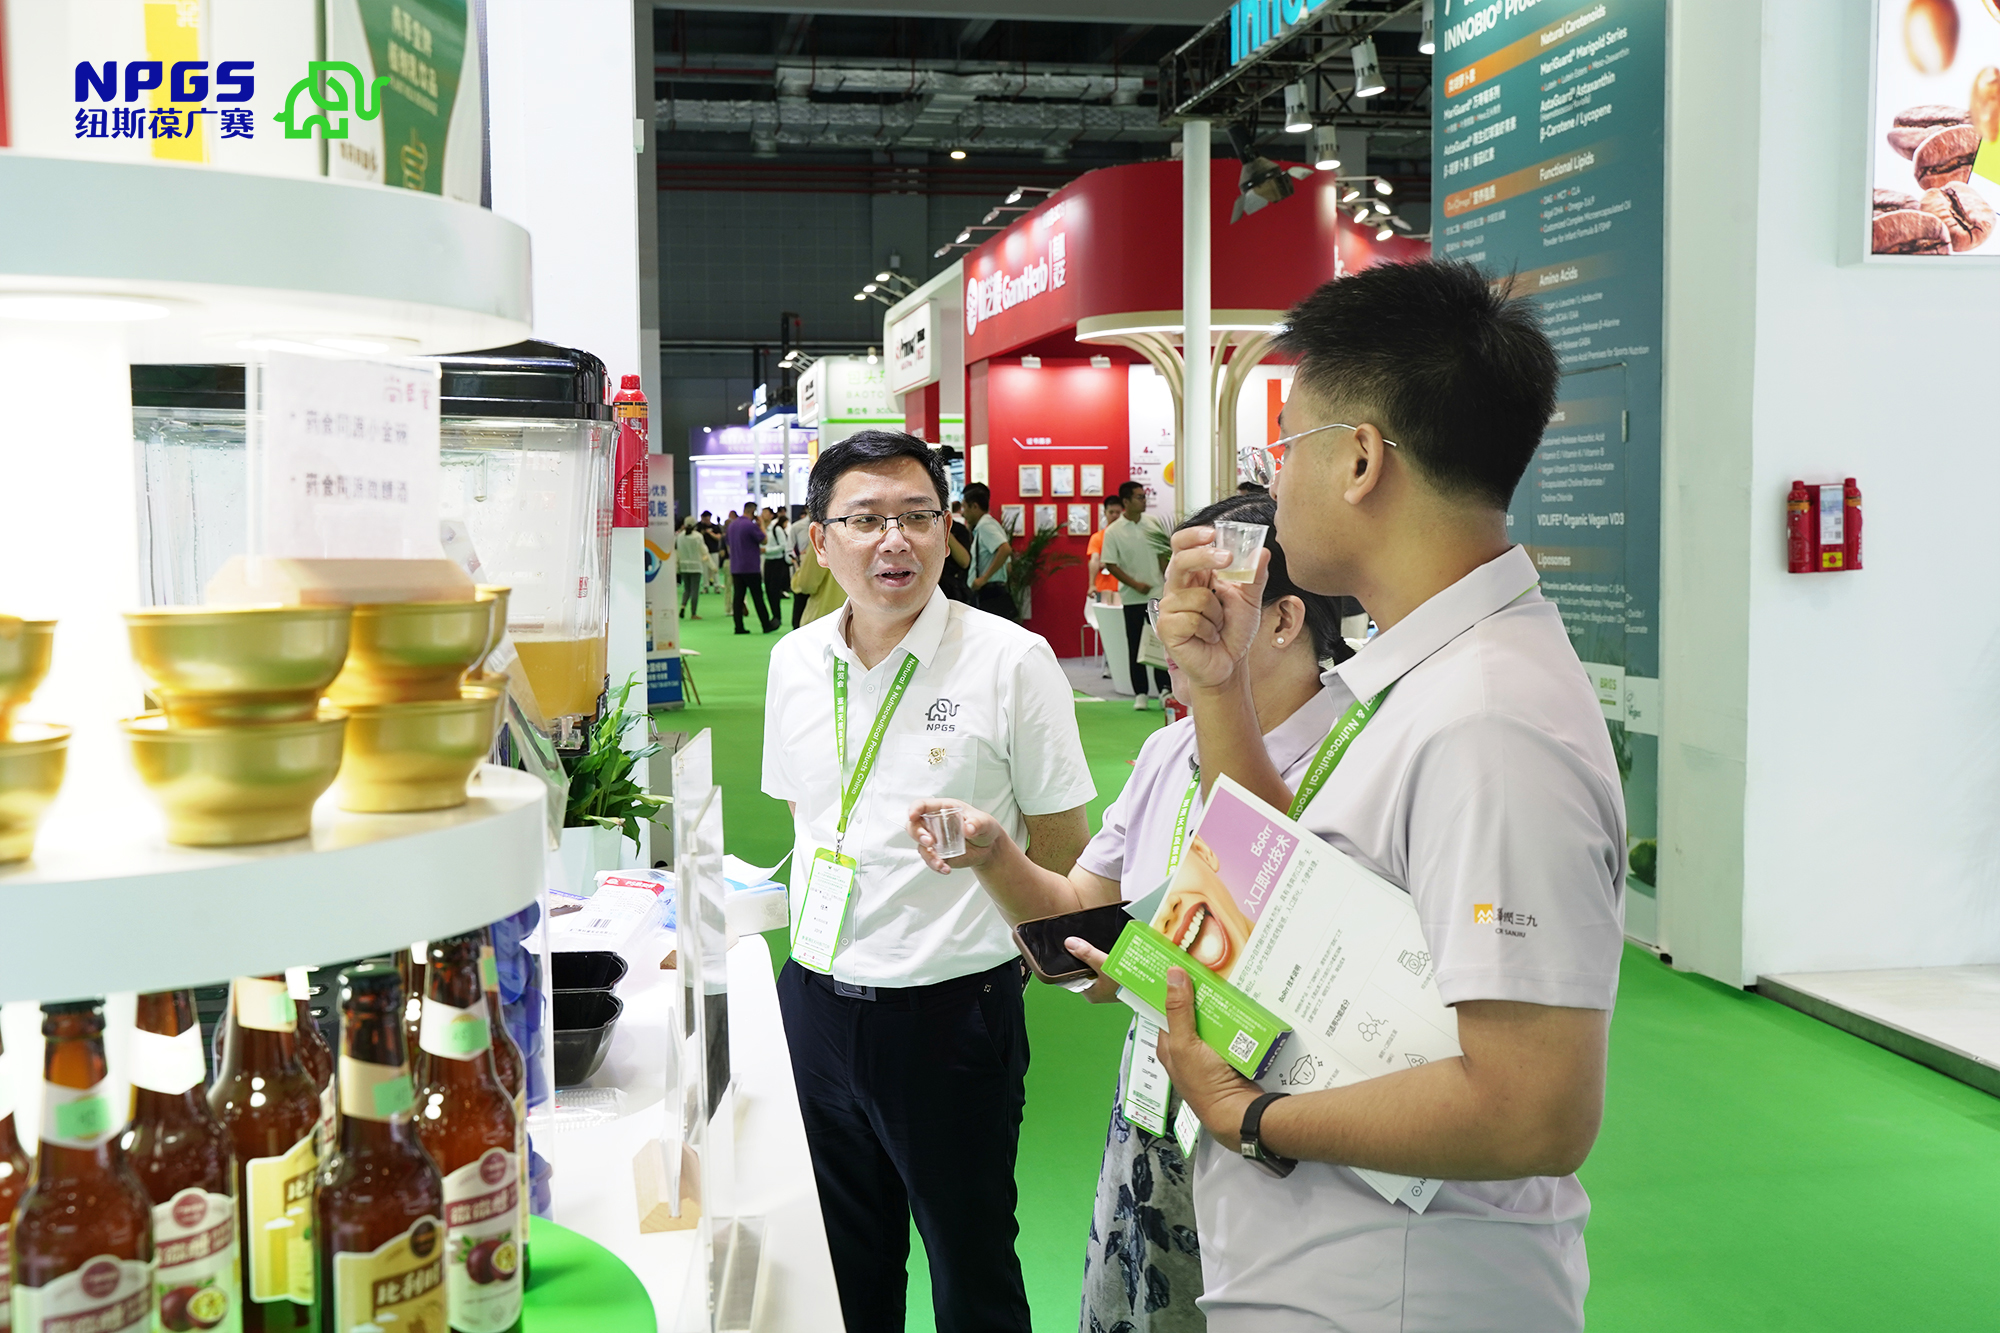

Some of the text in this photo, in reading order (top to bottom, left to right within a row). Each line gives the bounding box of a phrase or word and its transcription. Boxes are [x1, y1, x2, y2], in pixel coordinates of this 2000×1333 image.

[1540, 3, 1605, 46] Natural Carotenoids
[1606, 25, 1627, 45] Series
[1579, 103, 1611, 127] Lycopene
[1539, 151, 1594, 181] Functional Lipids
[1539, 267, 1578, 287] Amino Acids
[1563, 514, 1587, 529] Organic
[1588, 513, 1608, 528] Vegan
[1609, 512, 1624, 525] VD3
[1537, 553, 1570, 567] Liposomes
[900, 658, 916, 685] Natural
[873, 691, 899, 742] Nutraceutical
[926, 723, 955, 732] NPGS
[860, 740, 877, 772] Products
[1309, 718, 1359, 786] Nutraceutical
[851, 773, 865, 795] China
[1243, 834, 1291, 914] 入口即化技术
